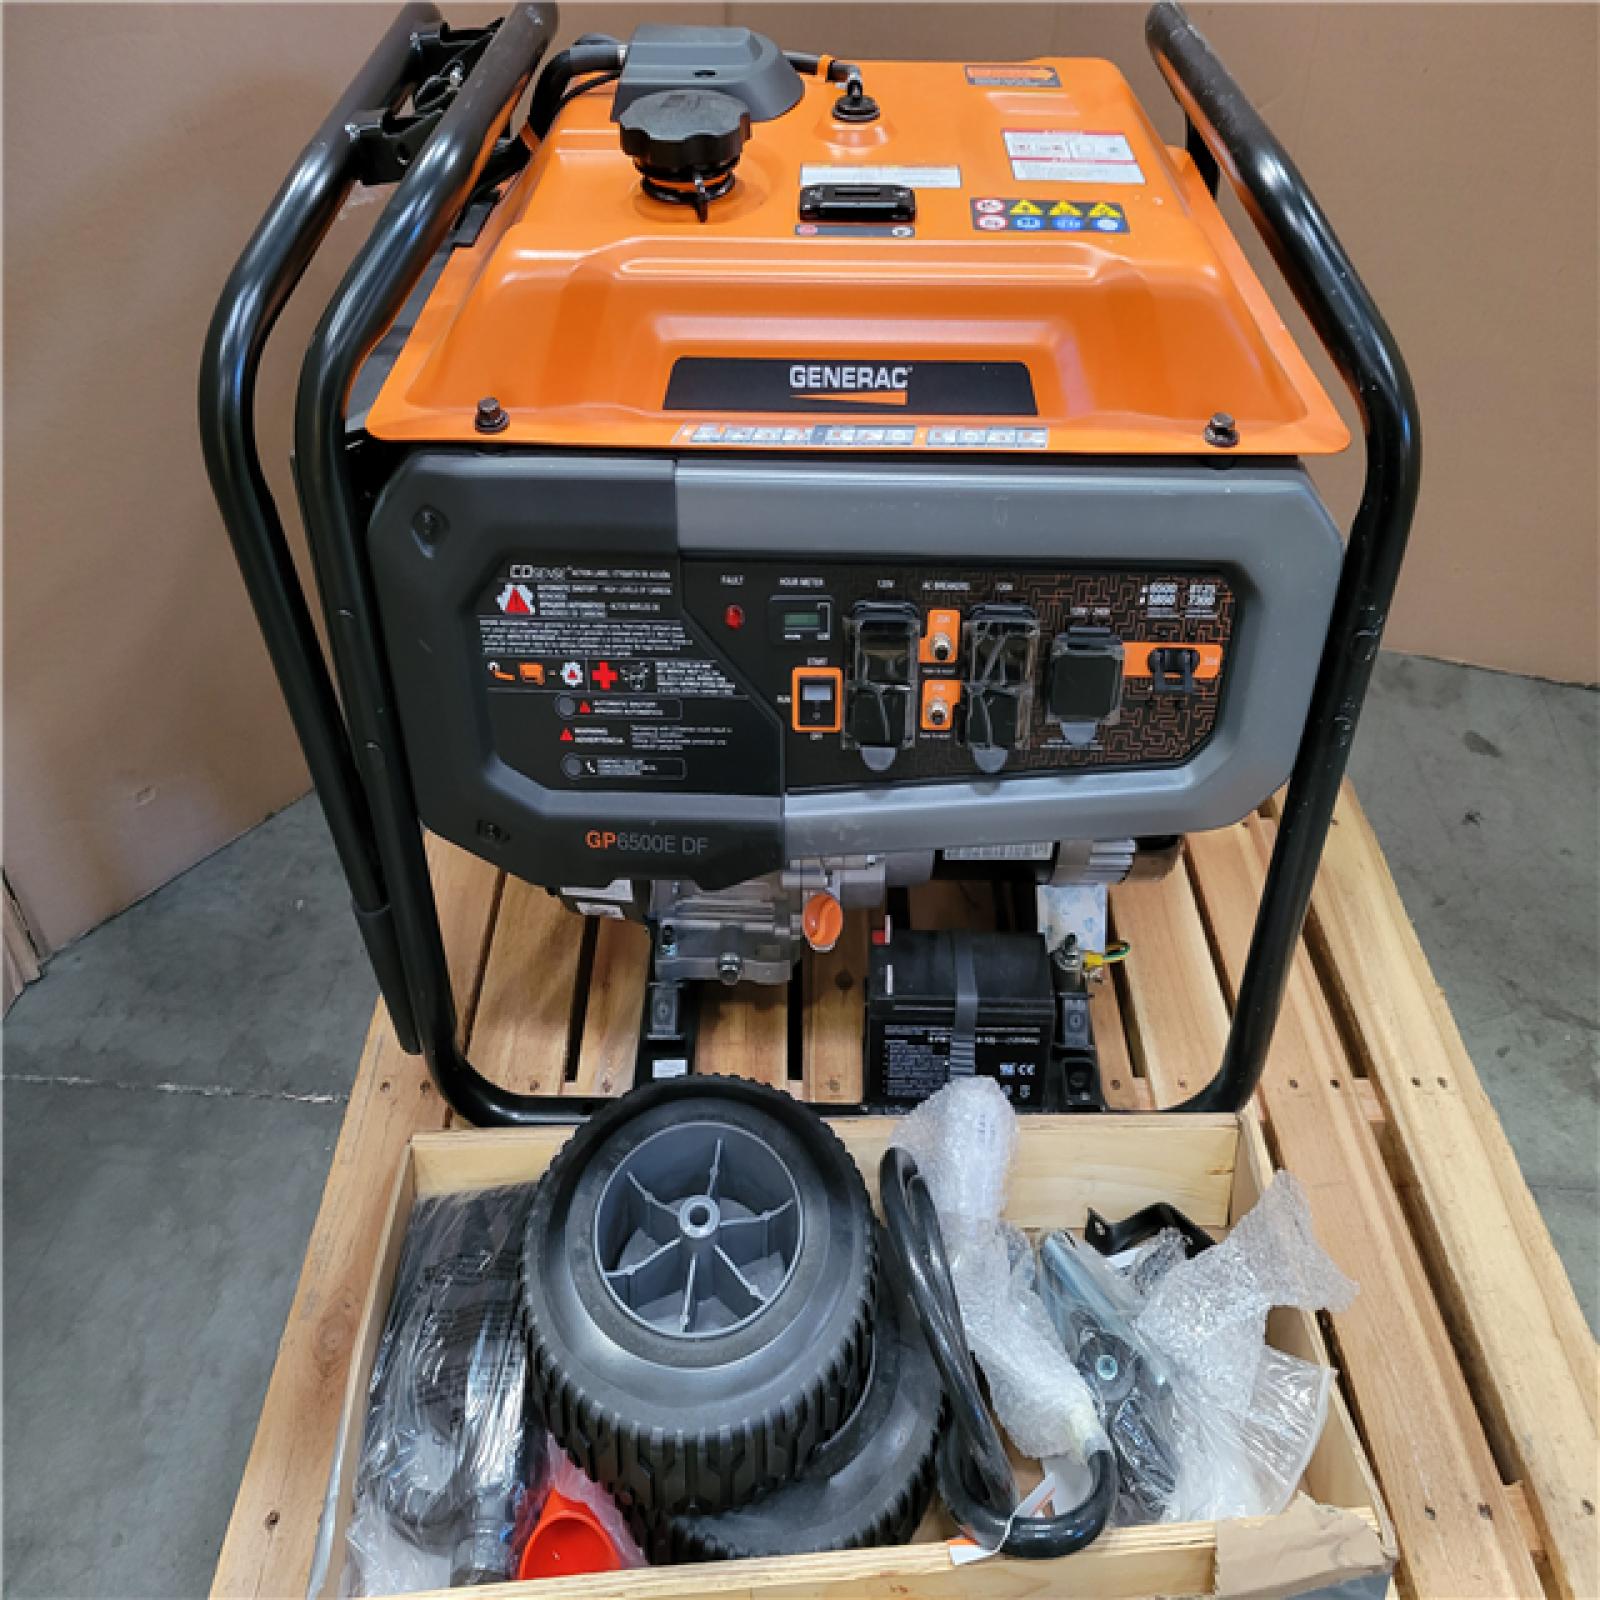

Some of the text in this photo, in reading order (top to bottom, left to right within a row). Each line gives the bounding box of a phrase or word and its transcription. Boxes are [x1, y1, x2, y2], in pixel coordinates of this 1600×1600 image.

[789, 365, 907, 388] GENERAC
[585, 830, 709, 855] GP6500E DF
